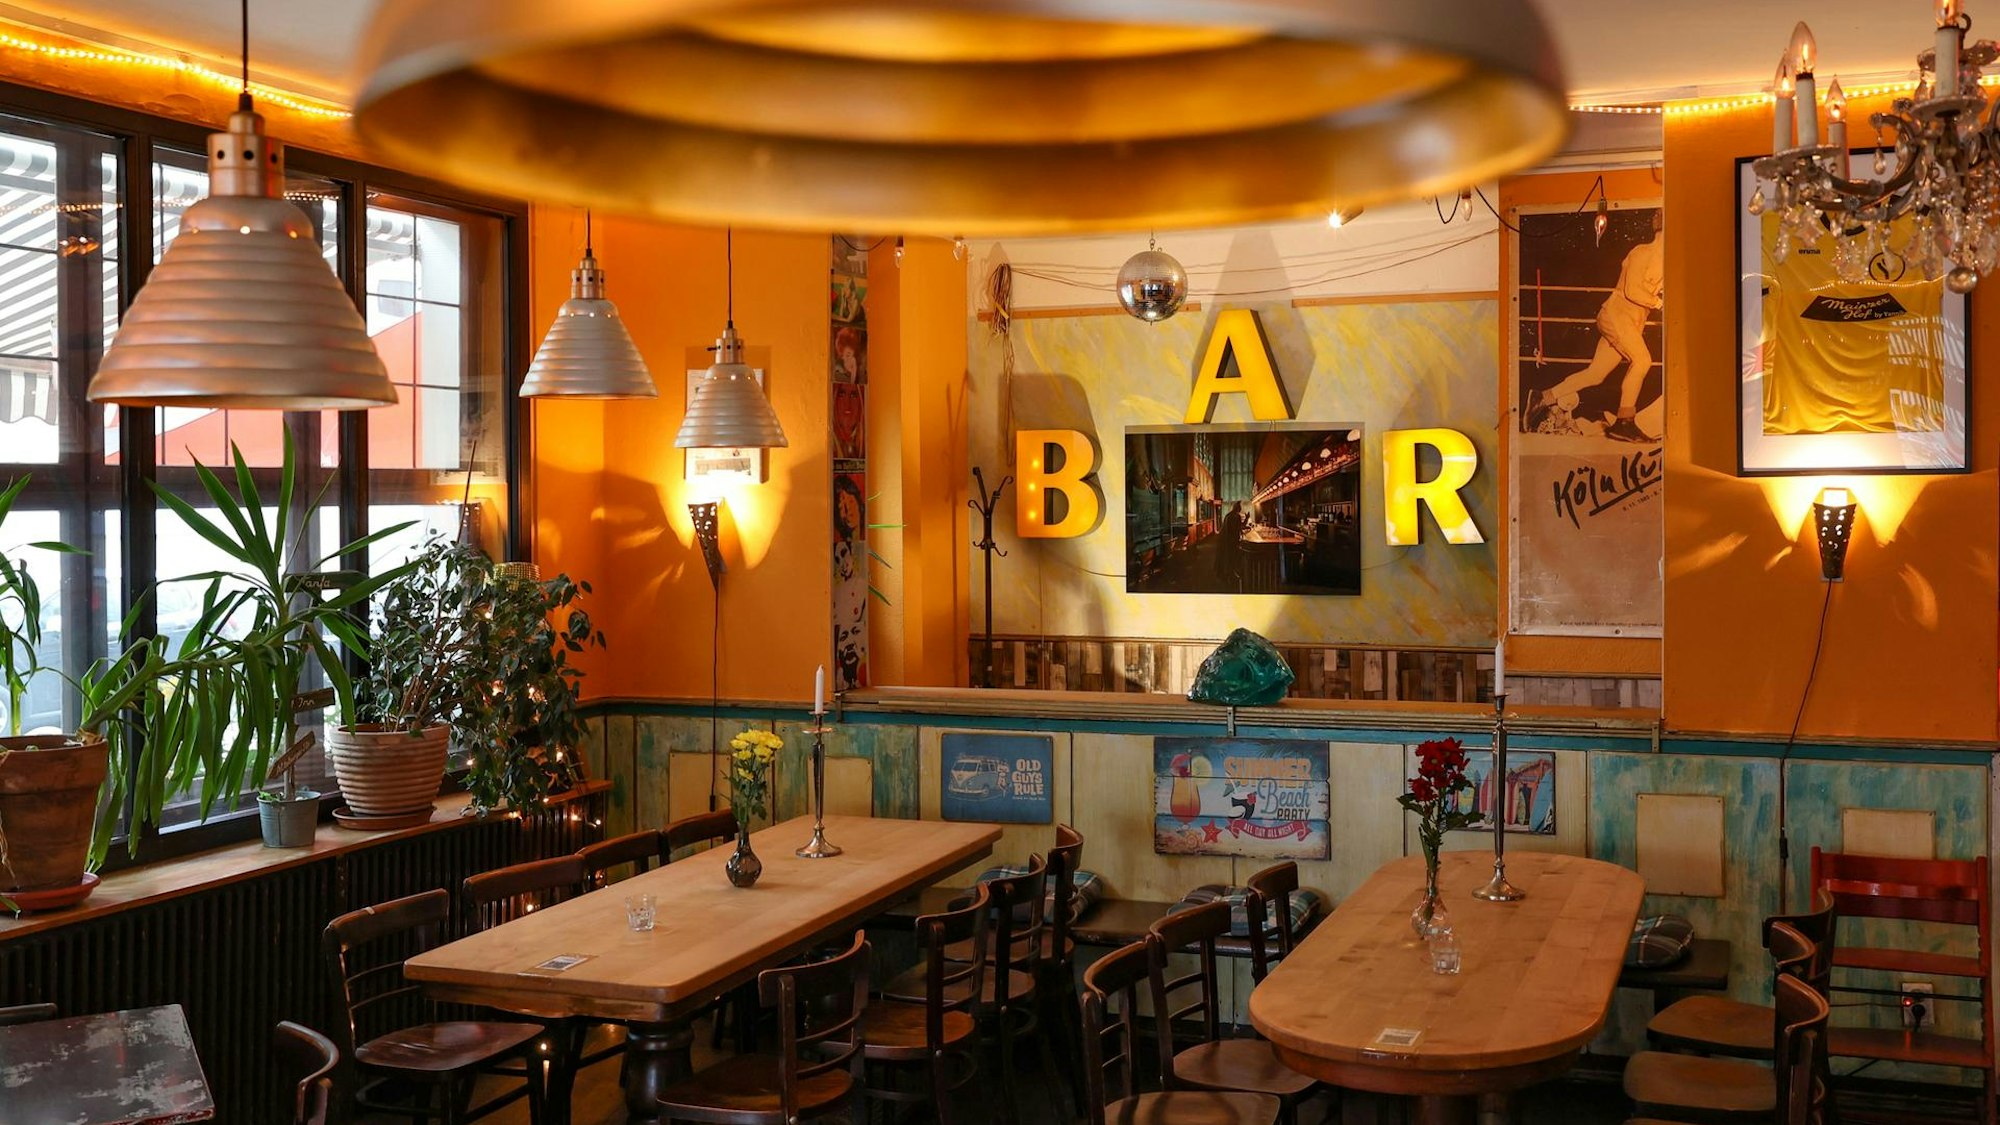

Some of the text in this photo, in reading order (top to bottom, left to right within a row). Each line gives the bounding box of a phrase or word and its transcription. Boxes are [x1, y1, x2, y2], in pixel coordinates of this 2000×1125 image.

[1841, 310, 1872, 319] Hof
[1016, 759, 1041, 772] OLD
[1012, 771, 1043, 783] GUYS
[1225, 758, 1313, 788] SUMMER
[1014, 783, 1044, 796] RULE
[1257, 778, 1310, 815] Beach
[1277, 808, 1311, 821] PARTY
[1243, 823, 1254, 833] ALL
[1267, 828, 1278, 837] ALL
